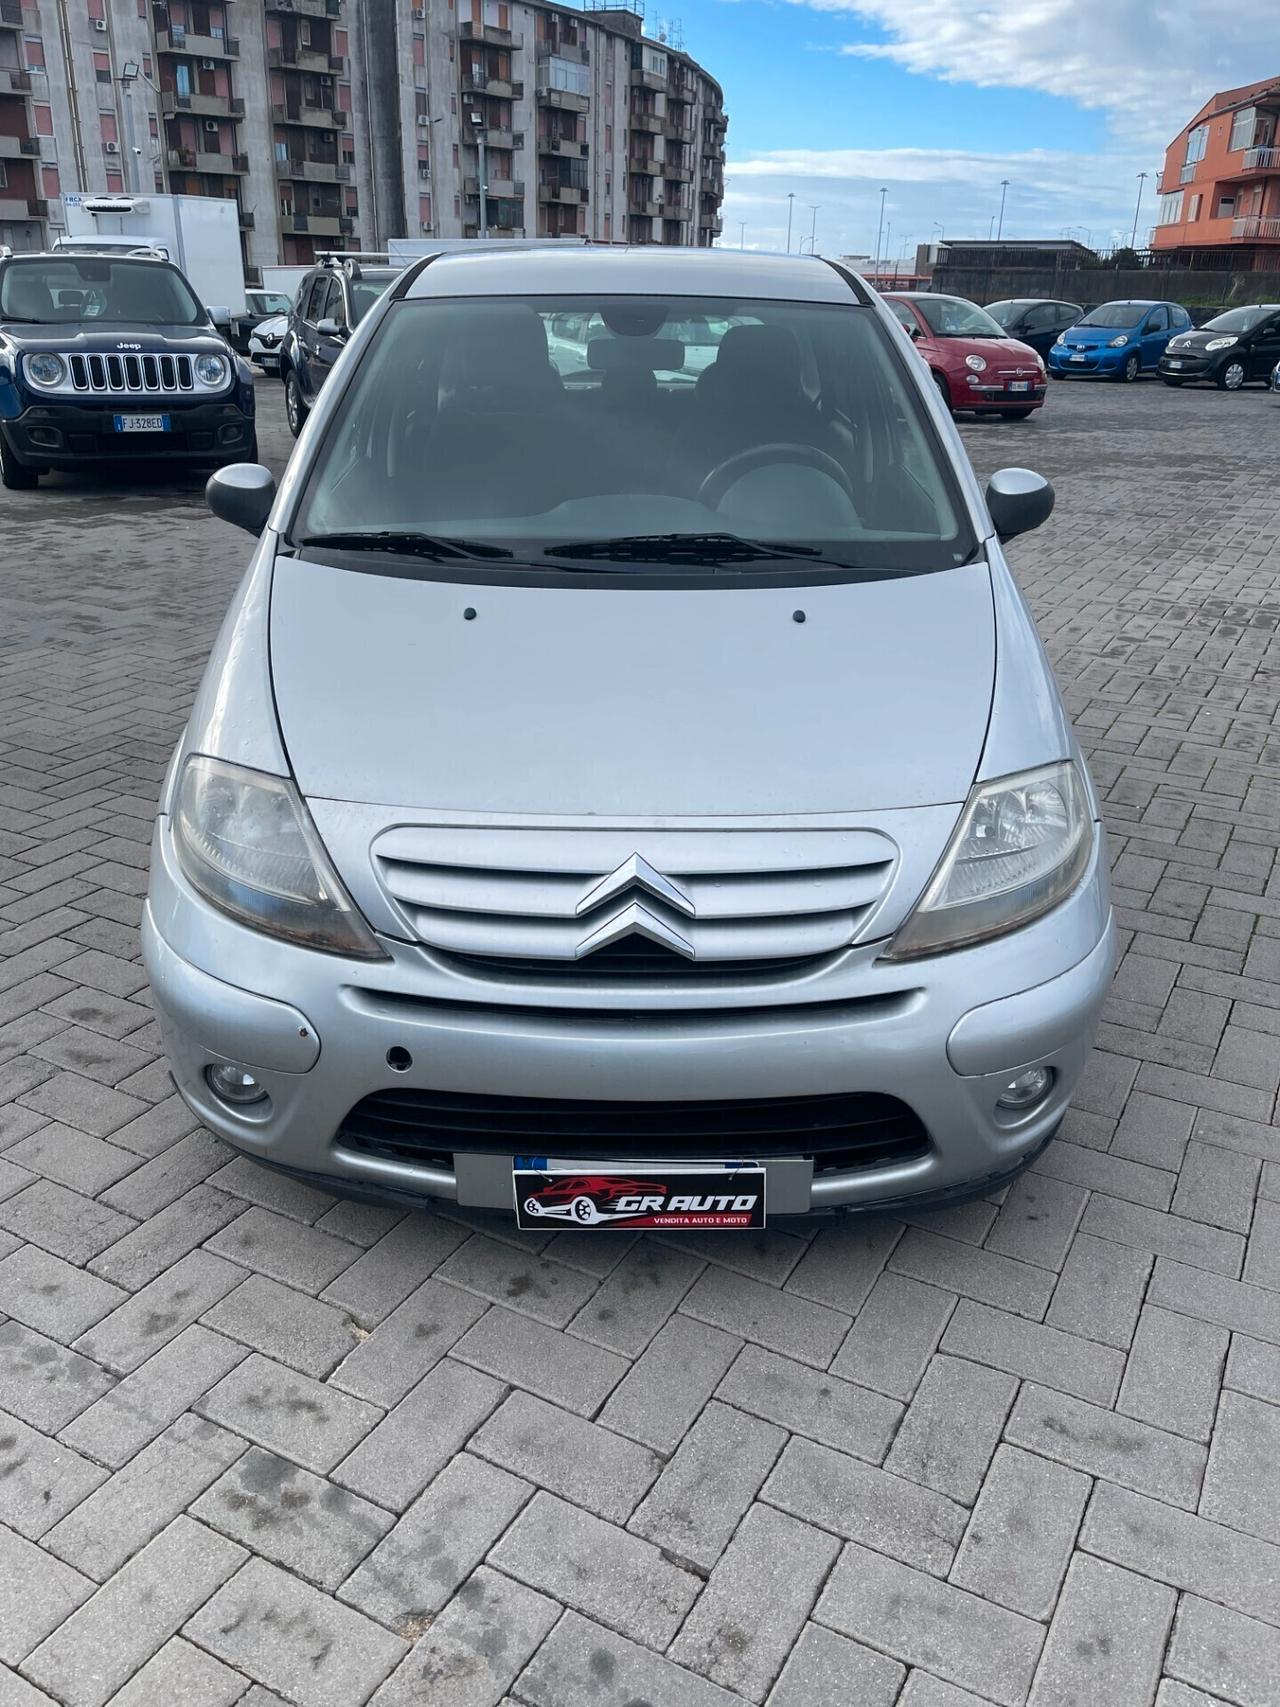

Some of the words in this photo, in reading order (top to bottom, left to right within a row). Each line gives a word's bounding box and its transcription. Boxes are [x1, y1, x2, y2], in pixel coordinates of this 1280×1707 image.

[116, 342, 141, 350] Jeep
[615, 1195, 665, 1211] GR
[666, 1195, 758, 1211] AUTO
